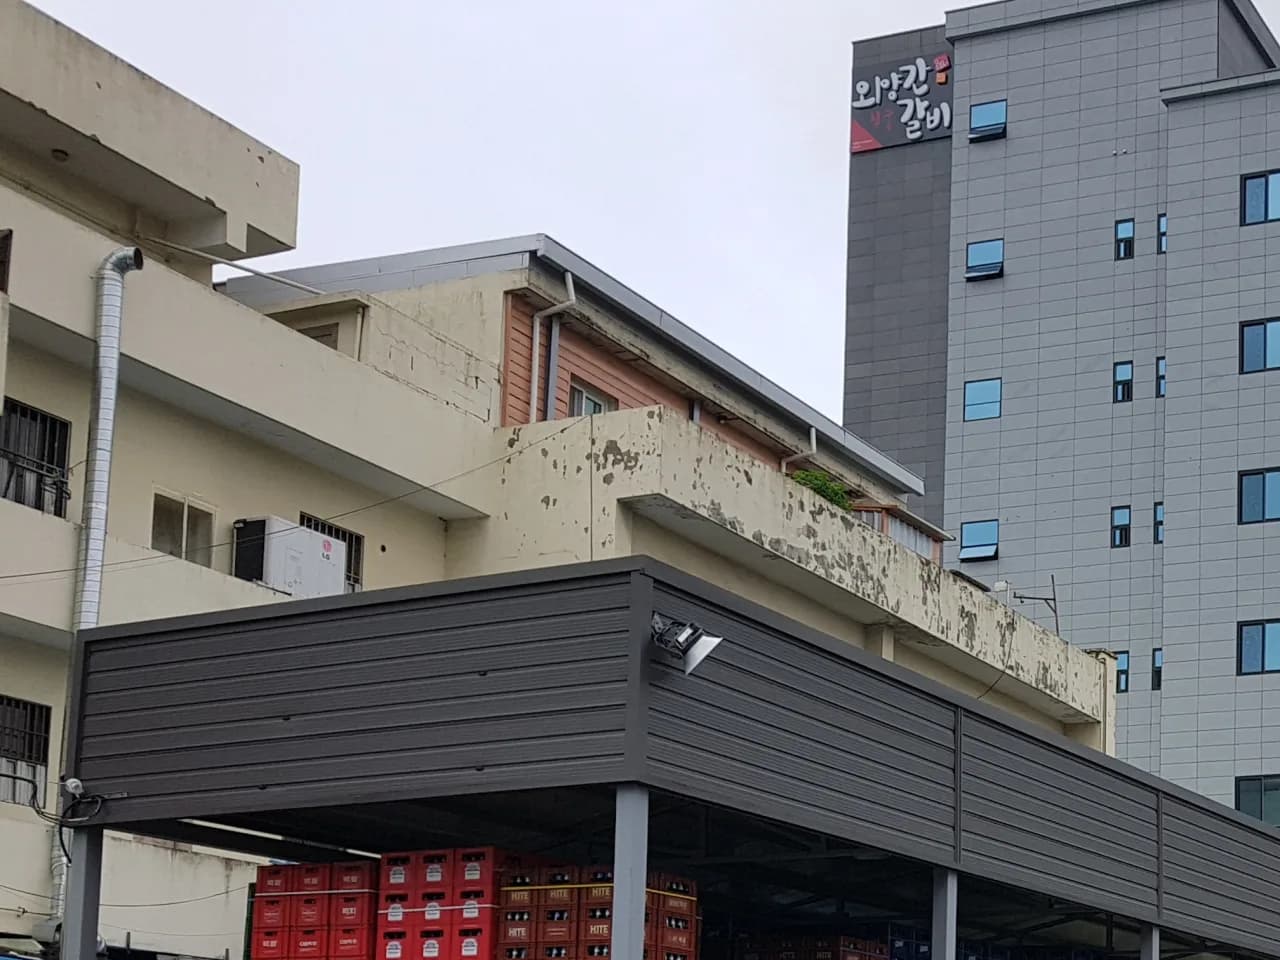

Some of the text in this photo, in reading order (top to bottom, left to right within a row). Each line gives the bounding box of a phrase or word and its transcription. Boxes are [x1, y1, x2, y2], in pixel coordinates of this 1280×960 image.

[852, 57, 932, 109] 외양간
[896, 97, 951, 140] 갈비
[509, 928, 526, 937] HITE
[590, 925, 609, 935] HITE
